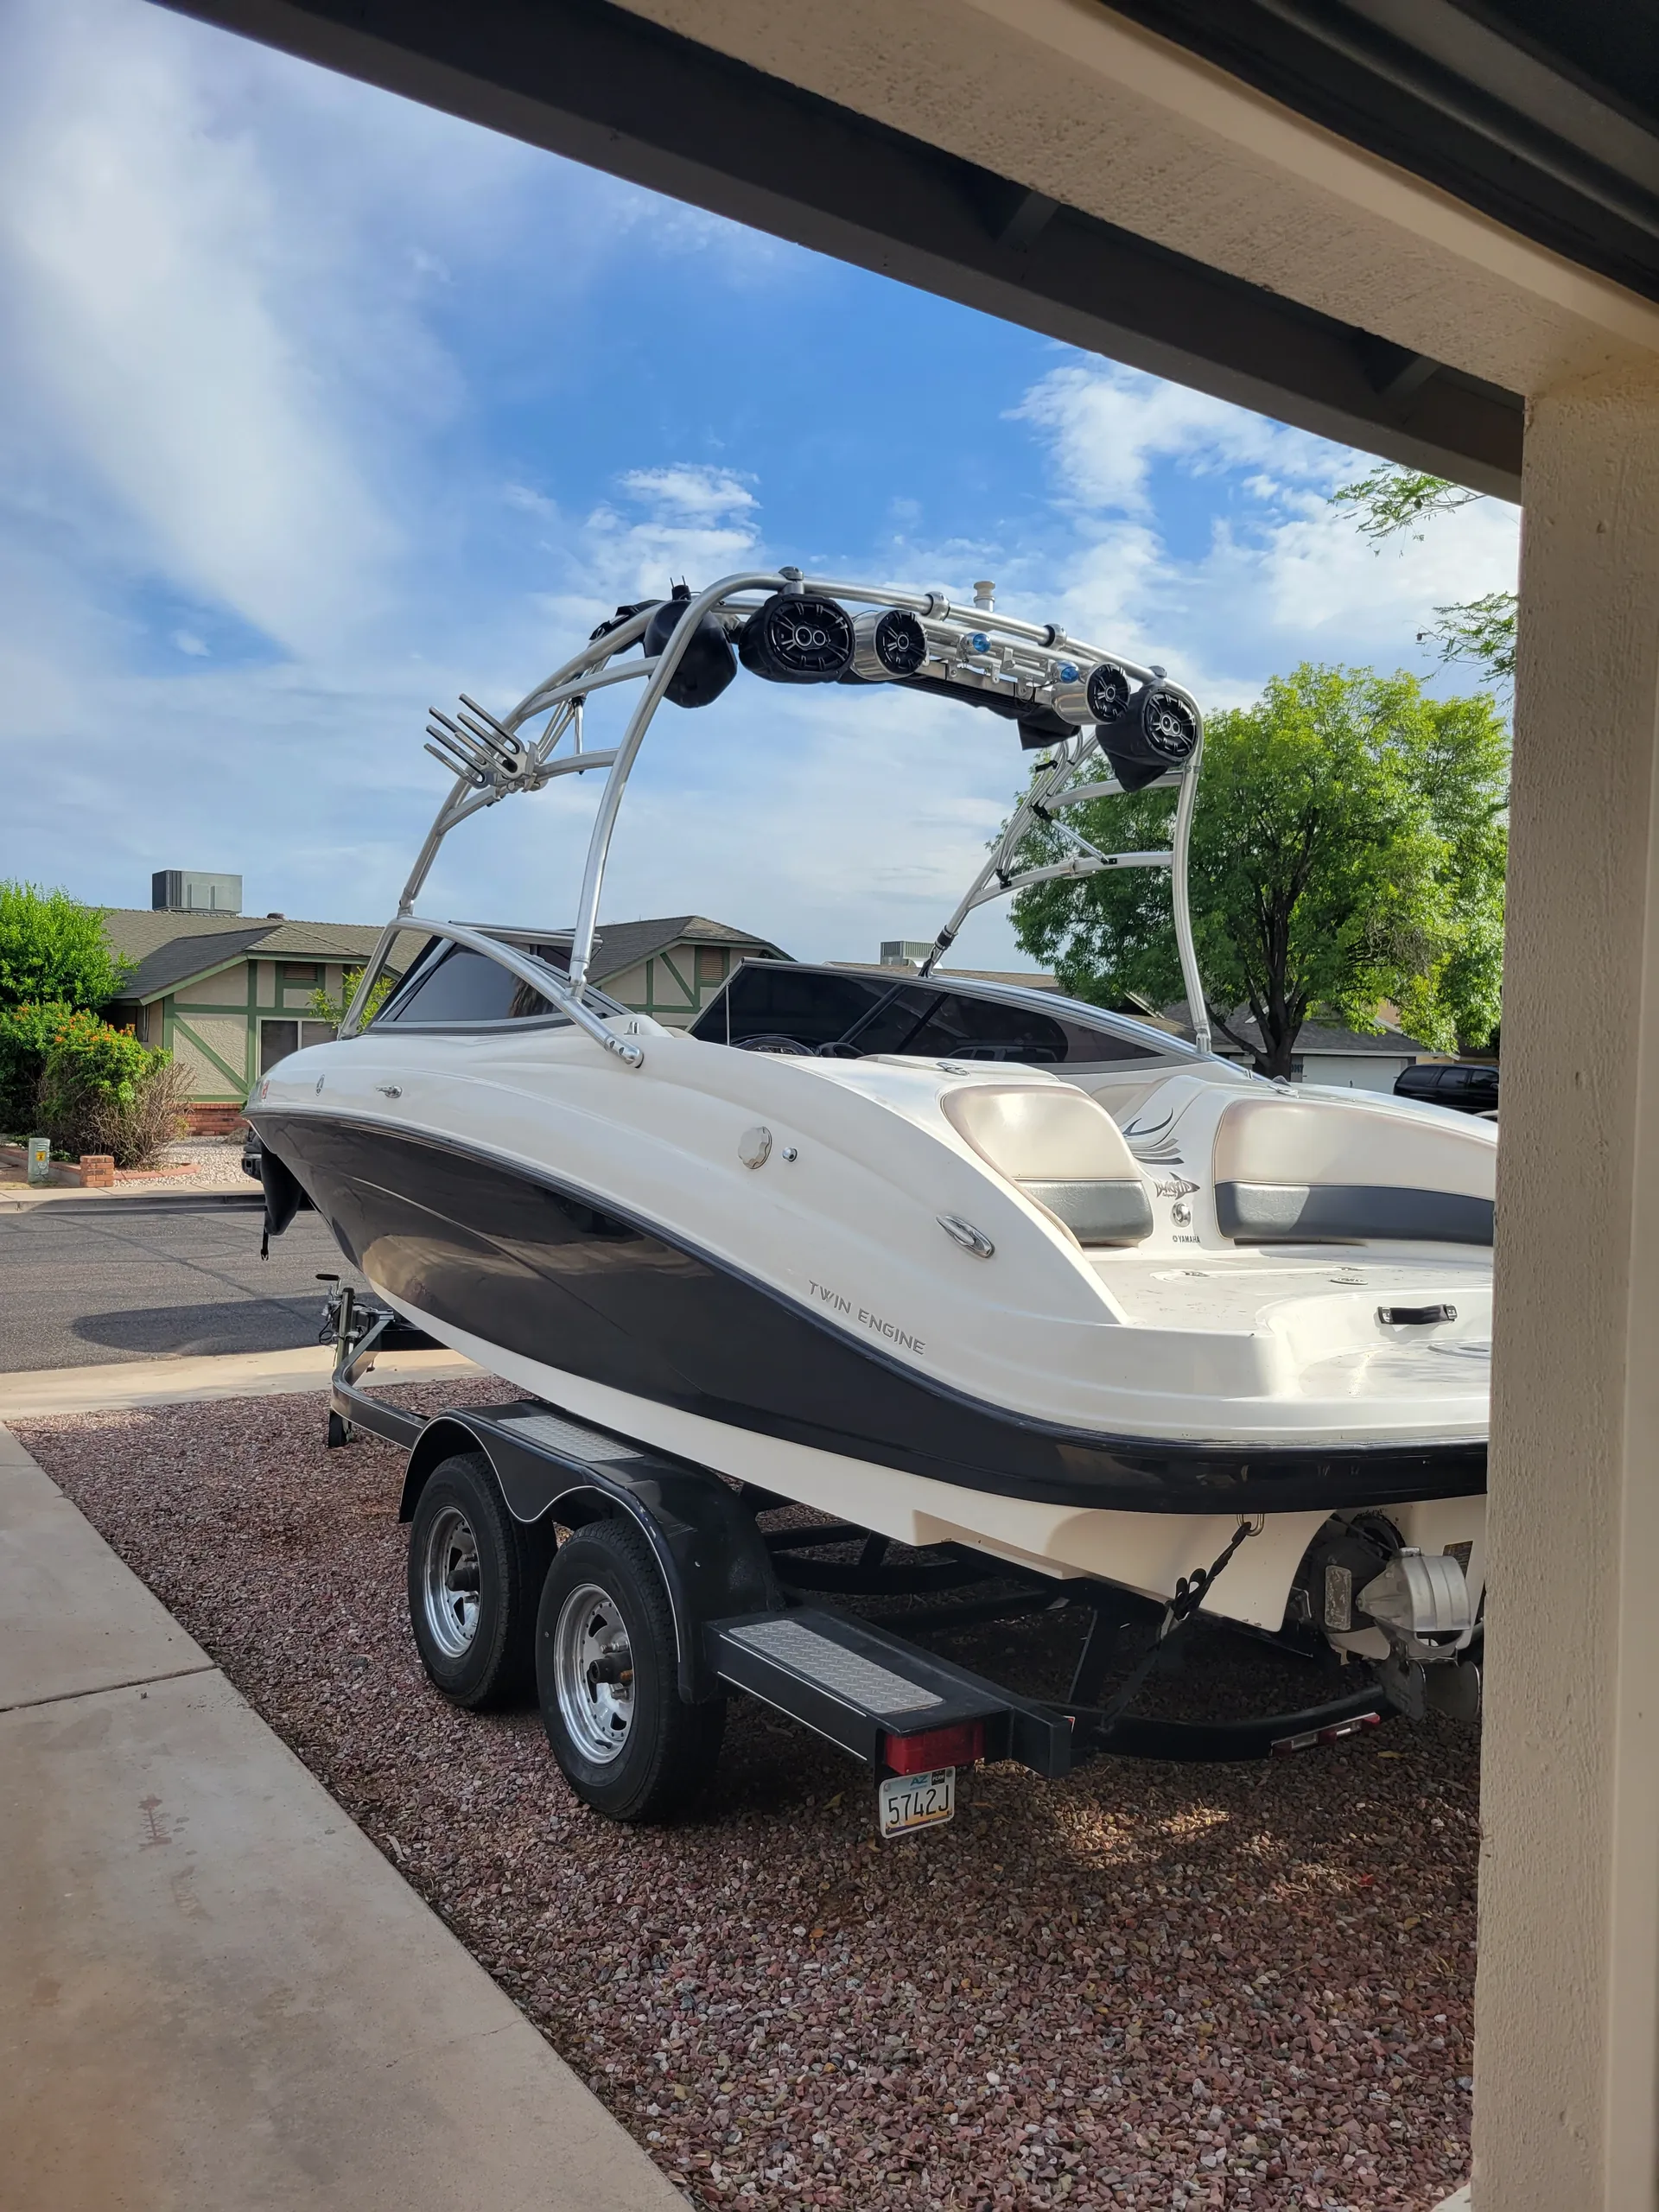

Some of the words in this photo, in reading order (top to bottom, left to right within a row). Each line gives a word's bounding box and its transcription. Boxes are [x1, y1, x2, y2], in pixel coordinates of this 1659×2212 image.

[1178, 1235, 1200, 1243] YAMAHA
[809, 1280, 851, 1314] TWIN
[857, 1307, 926, 1355] ENGINE
[910, 1775, 928, 1786] AZ
[888, 1784, 949, 1825] 5742J
